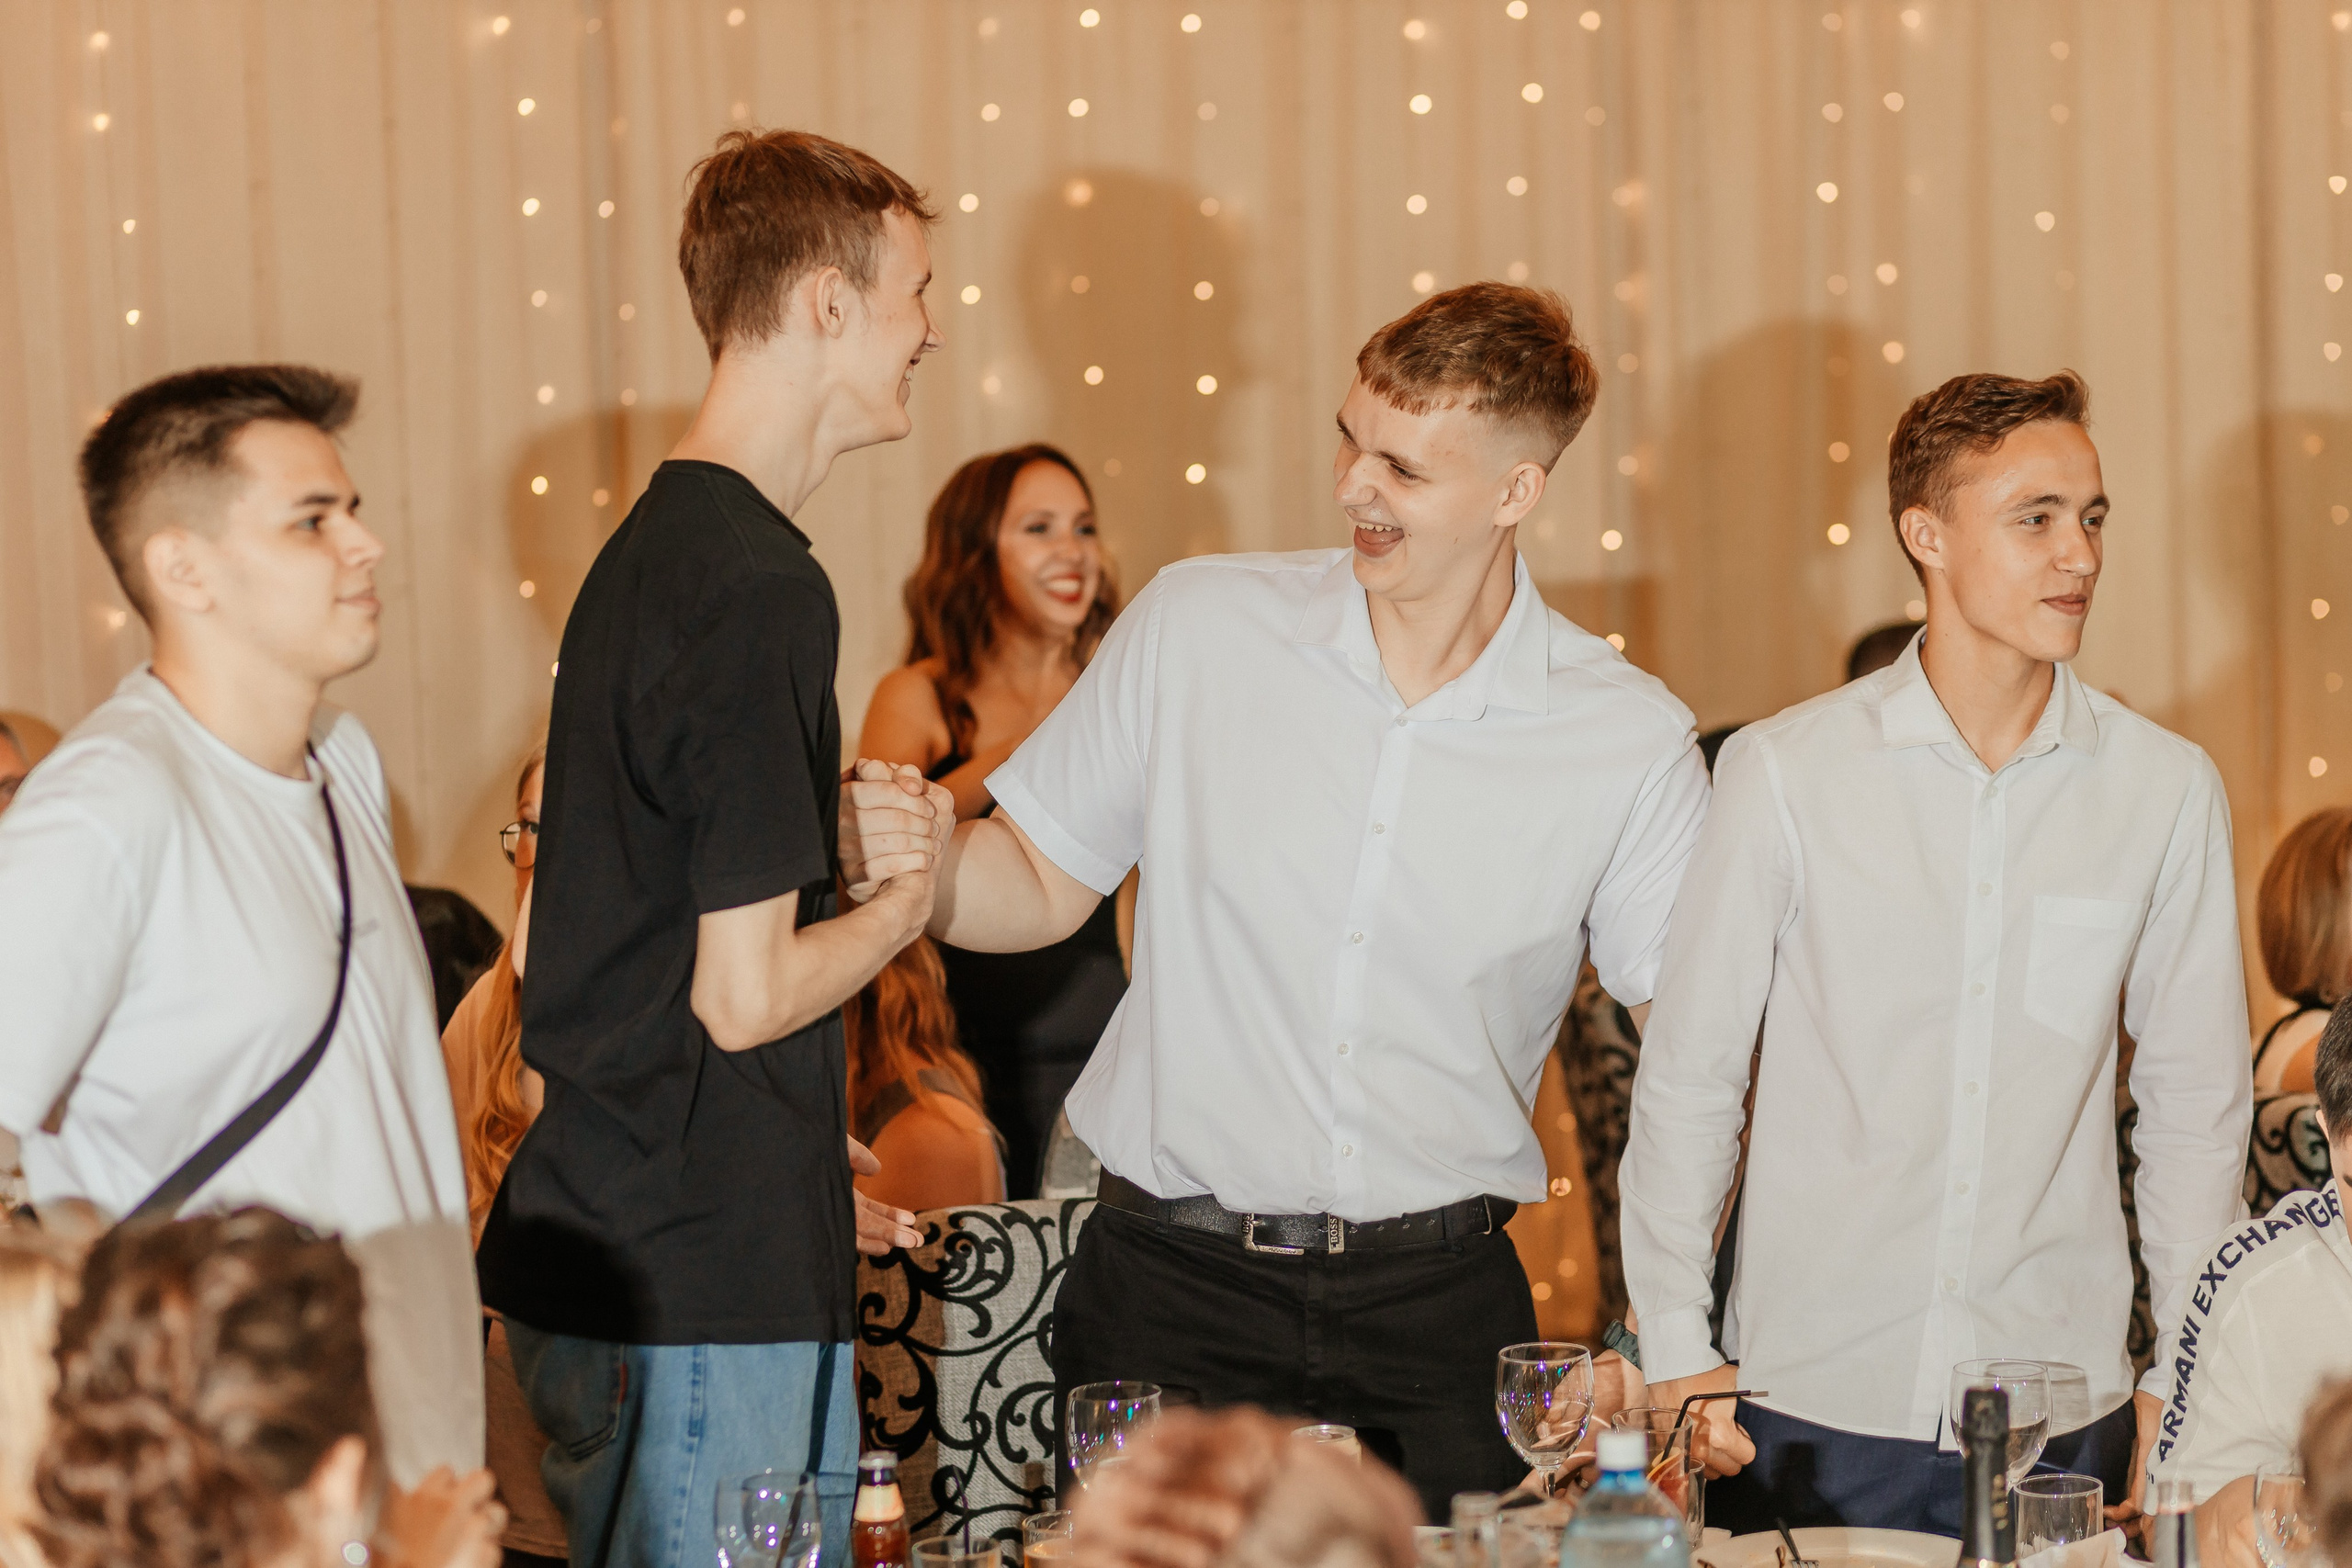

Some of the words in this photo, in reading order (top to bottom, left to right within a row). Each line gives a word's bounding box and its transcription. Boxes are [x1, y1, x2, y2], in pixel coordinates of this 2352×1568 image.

[1329, 1218, 1339, 1243] BOSS
[2159, 1314, 2201, 1462] ARMANI
[2192, 1189, 2341, 1316] EXCHANGE
